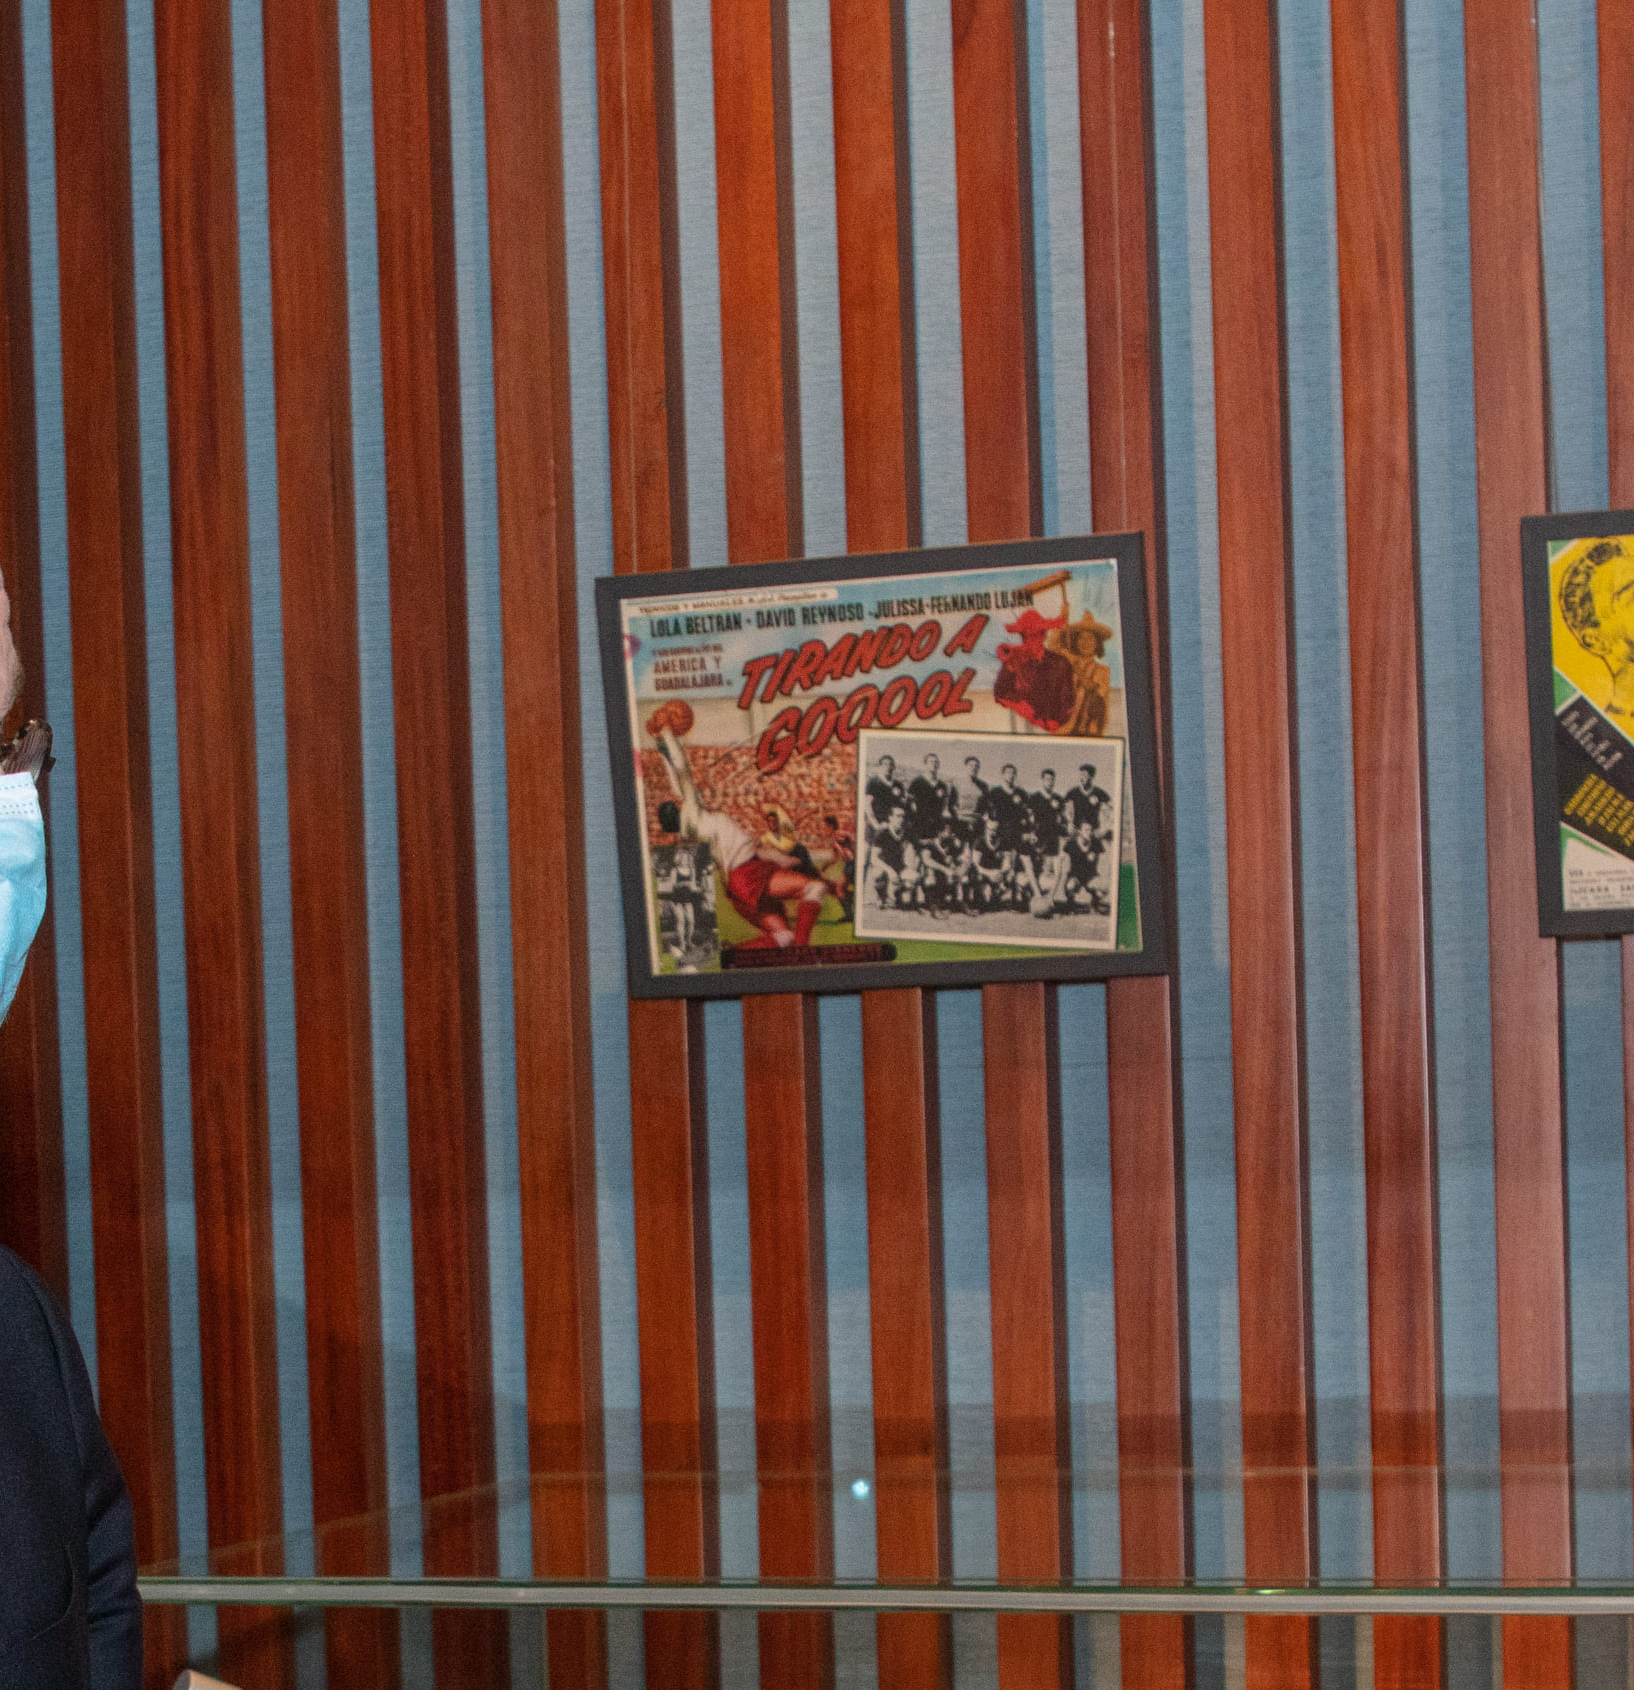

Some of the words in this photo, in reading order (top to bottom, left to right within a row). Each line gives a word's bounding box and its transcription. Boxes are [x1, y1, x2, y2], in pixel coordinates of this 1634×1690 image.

[650, 616, 683, 638] LOLA
[685, 611, 743, 635] BELTRAN
[755, 607, 797, 629] DAVID
[801, 601, 865, 626] REYNOSO
[737, 619, 942, 711] TIRANDO
[943, 613, 990, 658] A
[756, 667, 976, 776] GOOOOL
